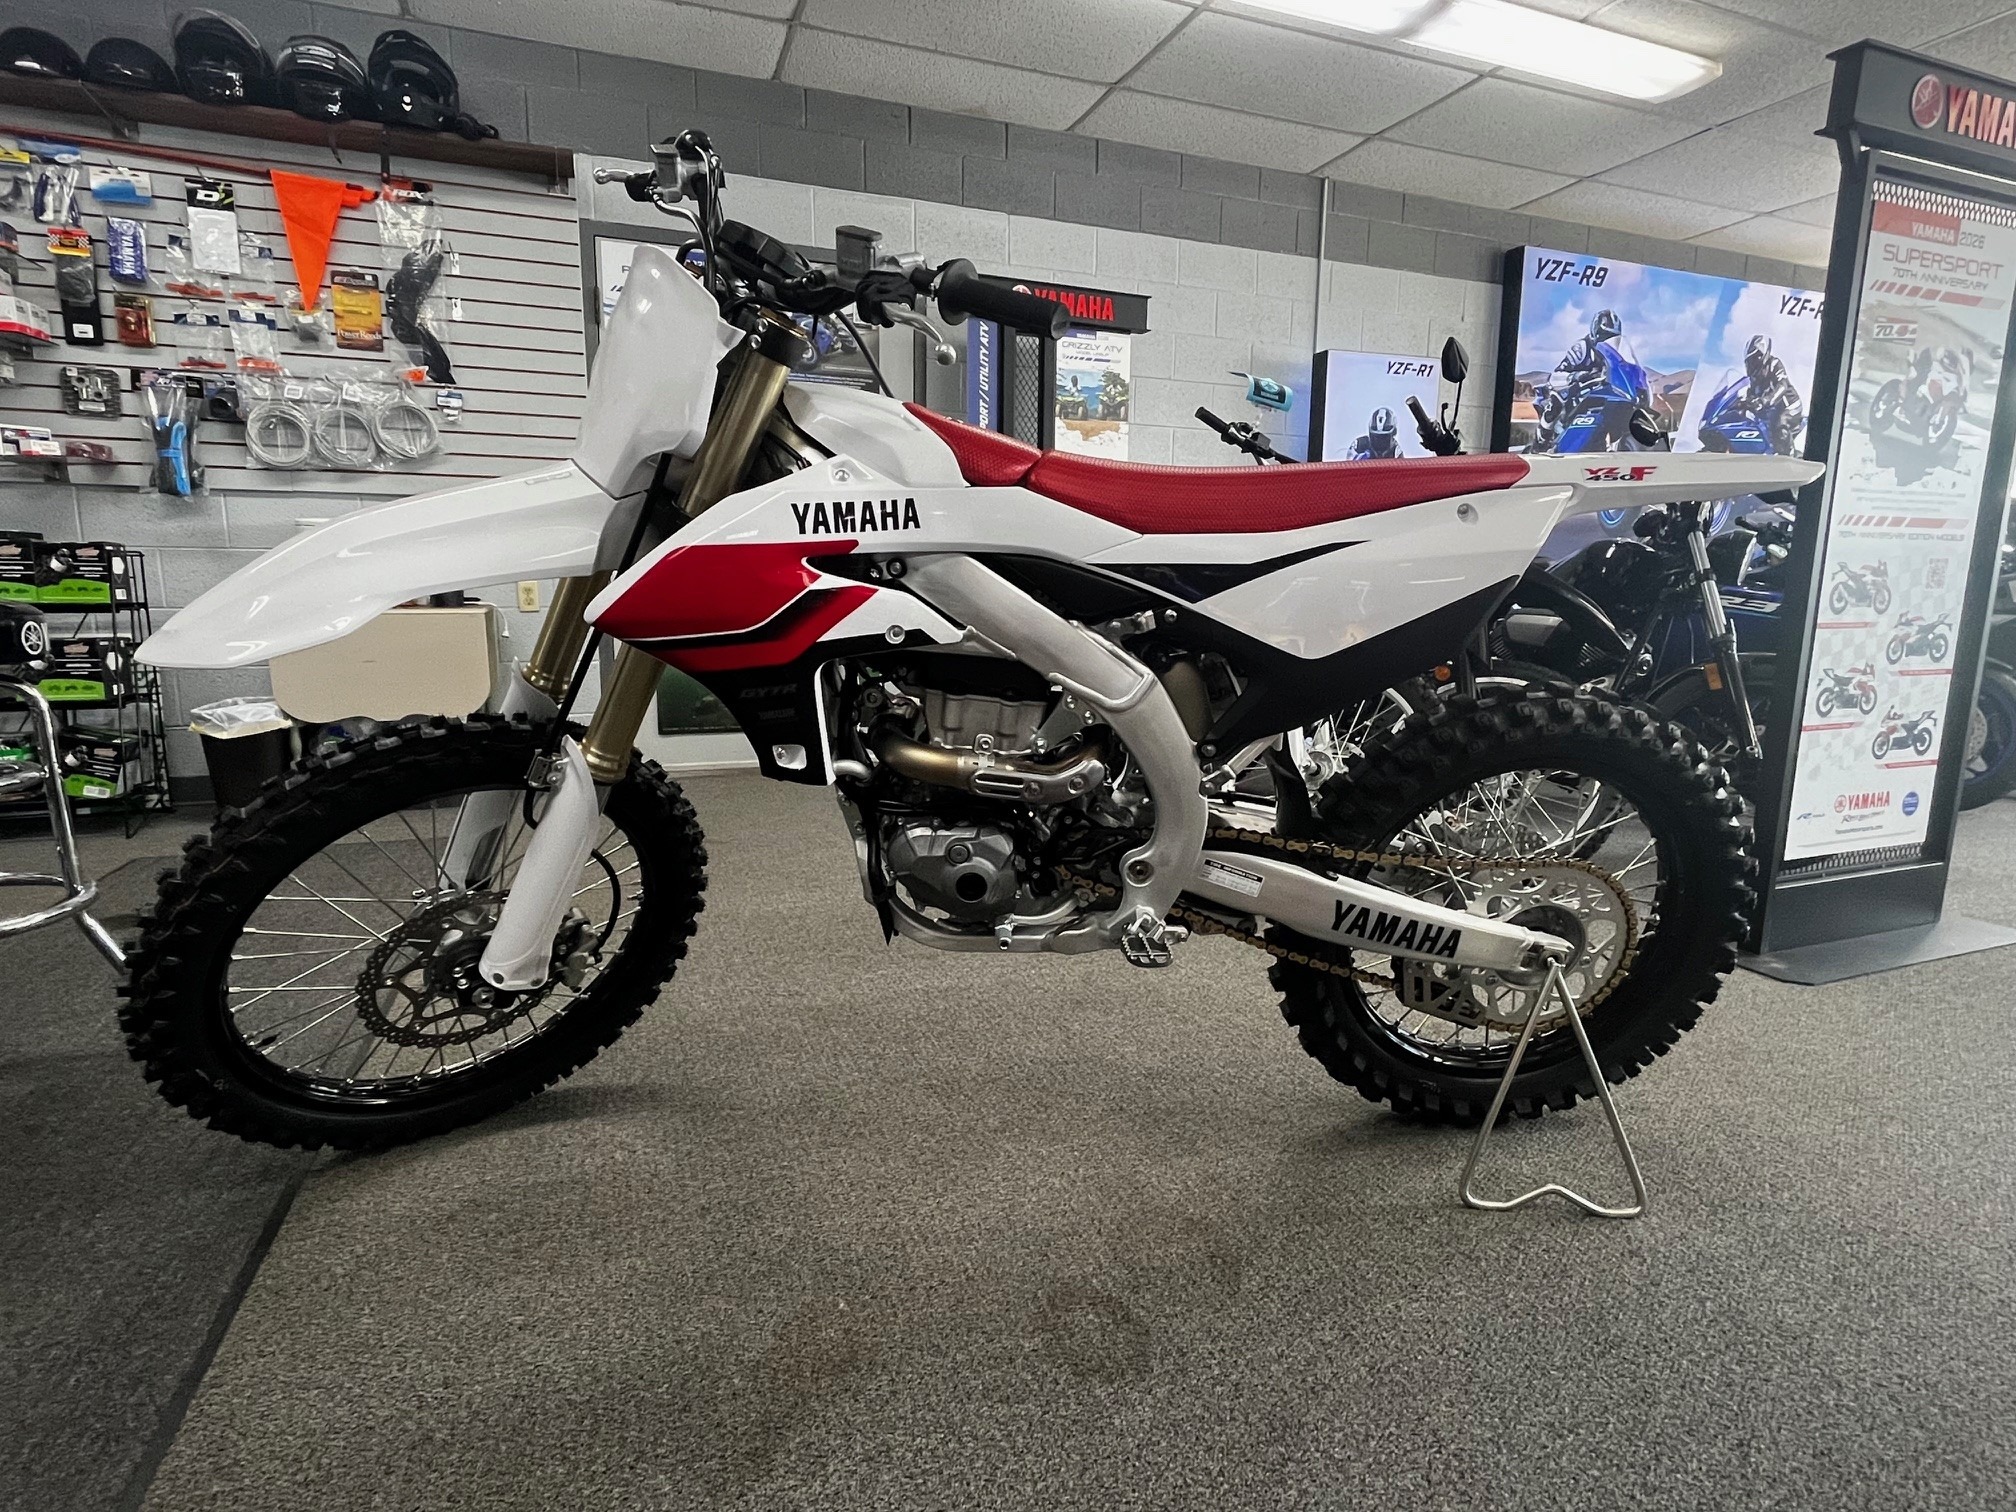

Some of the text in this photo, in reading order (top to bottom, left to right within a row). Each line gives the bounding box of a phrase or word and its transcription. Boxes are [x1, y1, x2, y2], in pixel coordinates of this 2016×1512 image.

[1947, 84, 2016, 149] YAMA
[1911, 222, 1986, 250] YAMAHA 2026
[120, 235, 135, 275] YAMAHA
[1882, 243, 2004, 280] SUPERSPORT
[1535, 257, 1609, 288] YZF-R9
[1919, 270, 1989, 291] ANNIVERSARY
[979, 321, 990, 347] ATV
[1061, 340, 1123, 354] GRIZZLY ATV
[979, 346, 990, 391] UTILITY
[1386, 360, 1435, 378] YZF-R1
[1573, 416, 1595, 426] R9
[790, 497, 921, 535] YAMAHA
[1848, 790, 1891, 811] YAMAHA
[1331, 899, 1462, 959] YAMAHA
